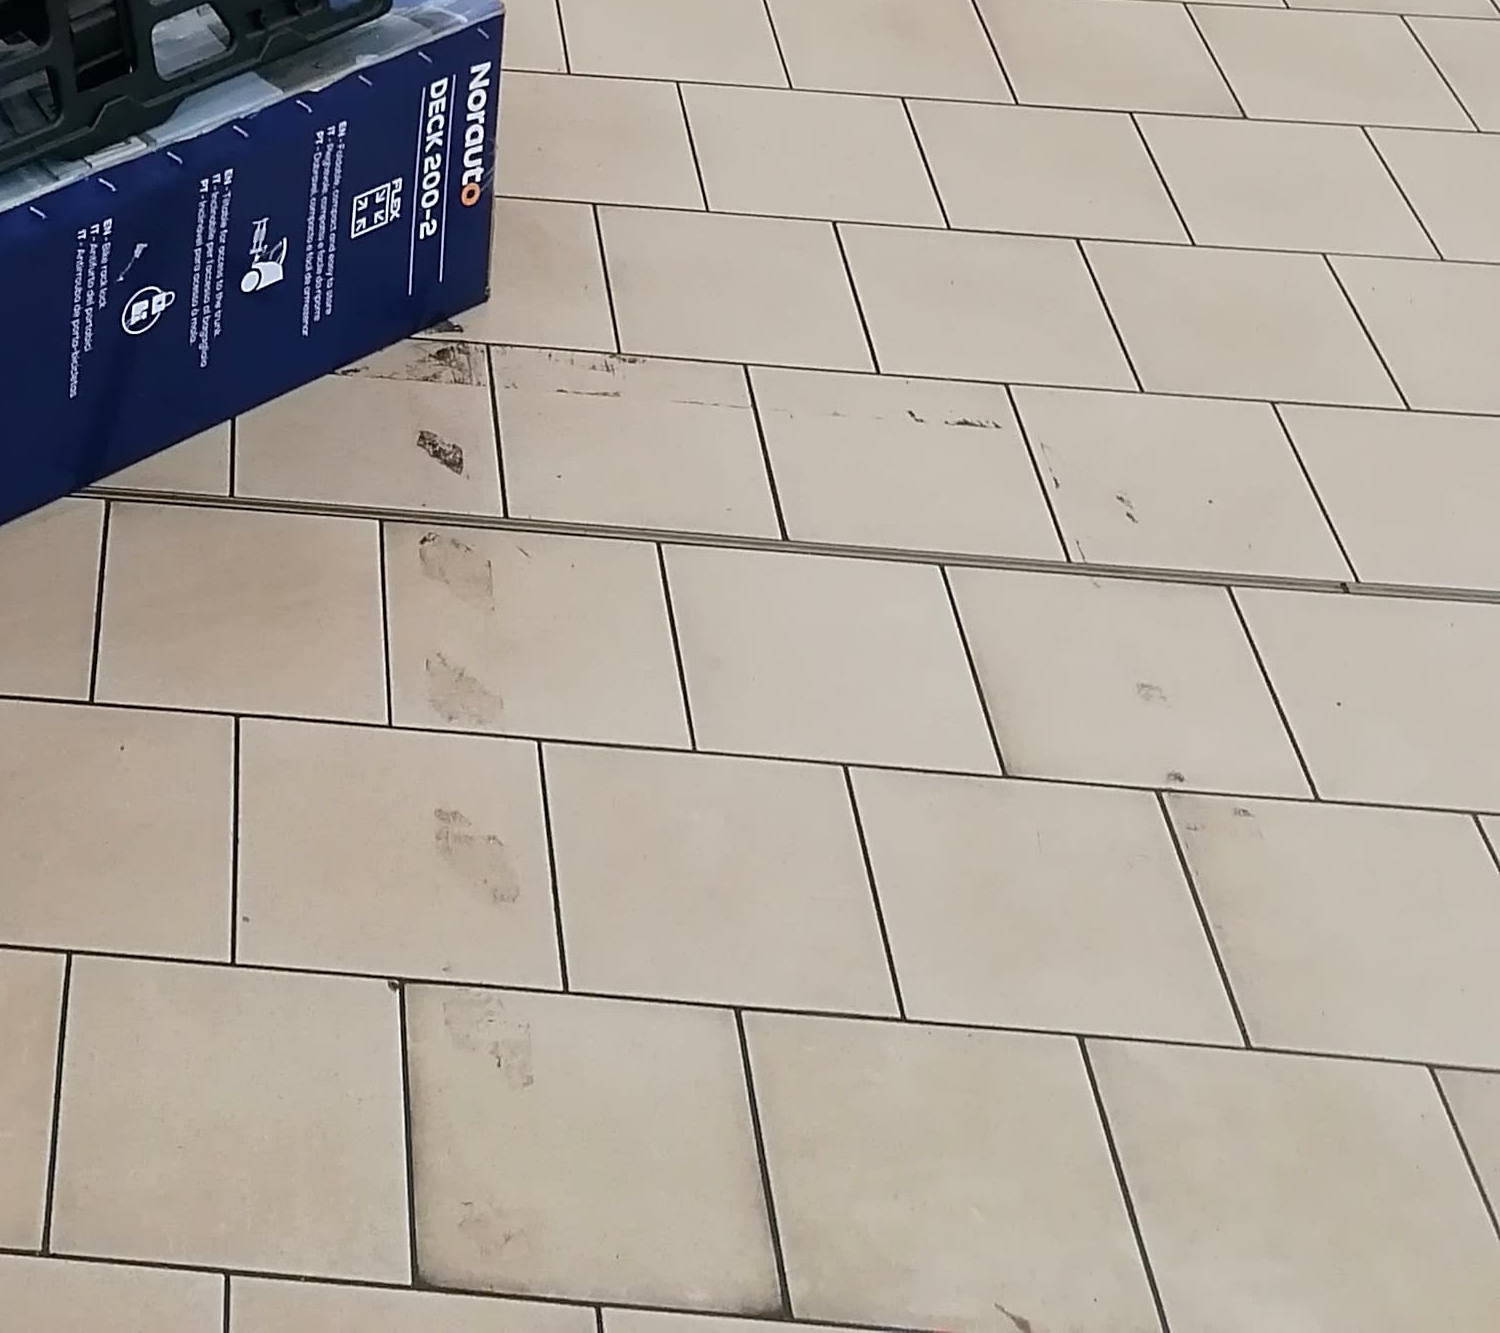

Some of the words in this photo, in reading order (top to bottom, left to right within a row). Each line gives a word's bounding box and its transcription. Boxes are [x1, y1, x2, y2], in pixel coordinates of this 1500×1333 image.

[337, 119, 346, 138] EN
[423, 77, 449, 153] DECK
[461, 61, 492, 207] Norauto
[223, 167, 233, 185] EN
[419, 153, 442, 240] 200-2
[101, 217, 112, 236] EN
